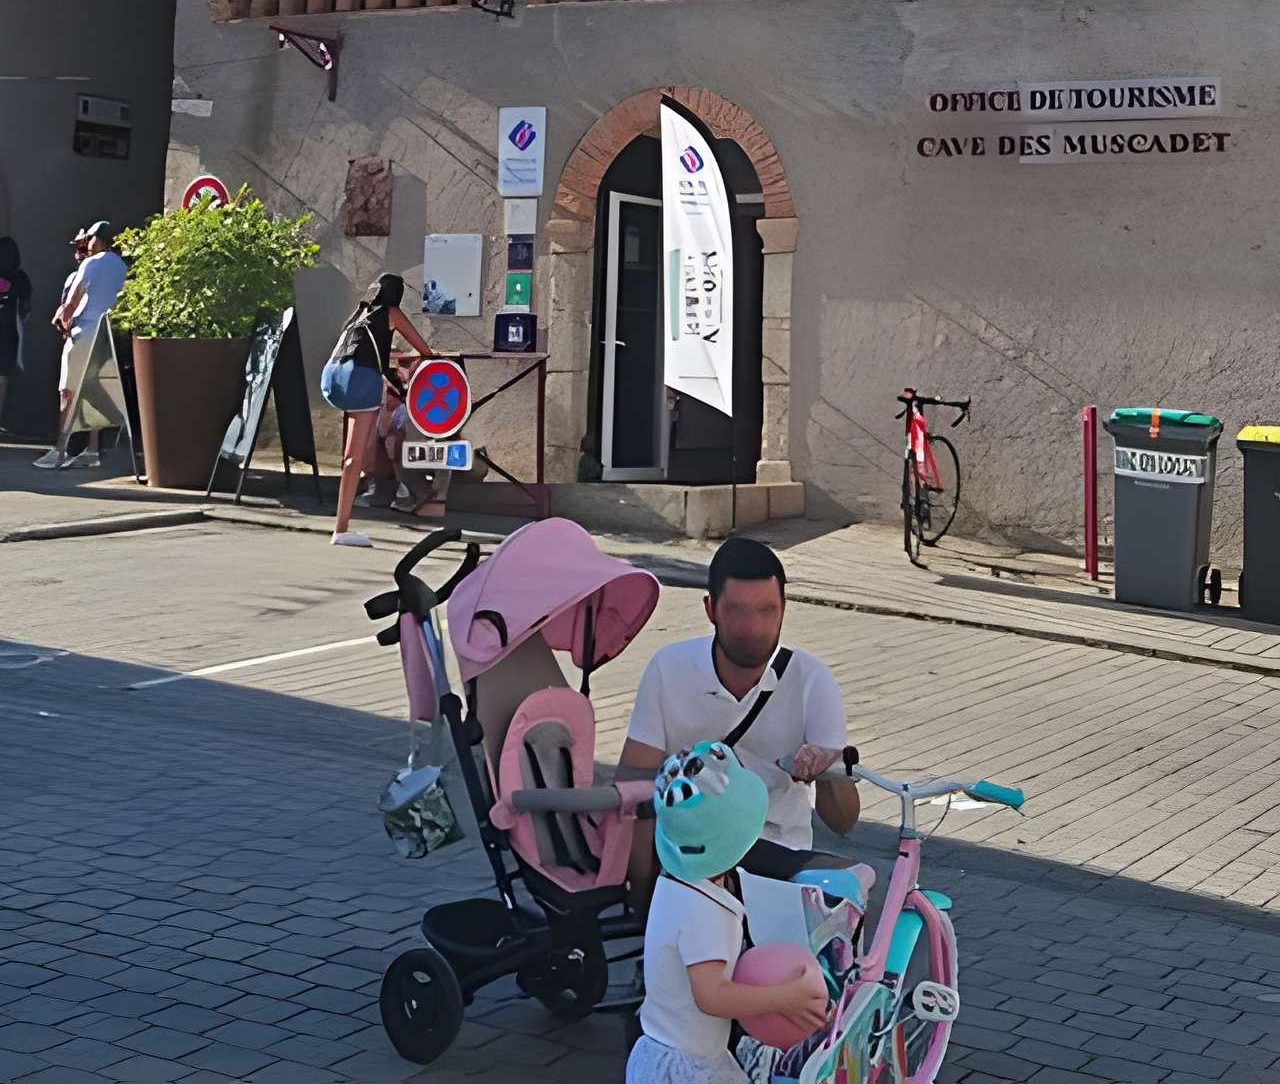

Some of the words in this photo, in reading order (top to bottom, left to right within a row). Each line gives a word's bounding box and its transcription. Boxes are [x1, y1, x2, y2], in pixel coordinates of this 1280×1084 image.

[1069, 84, 1216, 109] TOURISME
[917, 136, 986, 157] CAVE
[998, 135, 1051, 156] DES
[1063, 132, 1231, 155] MUSCADET
